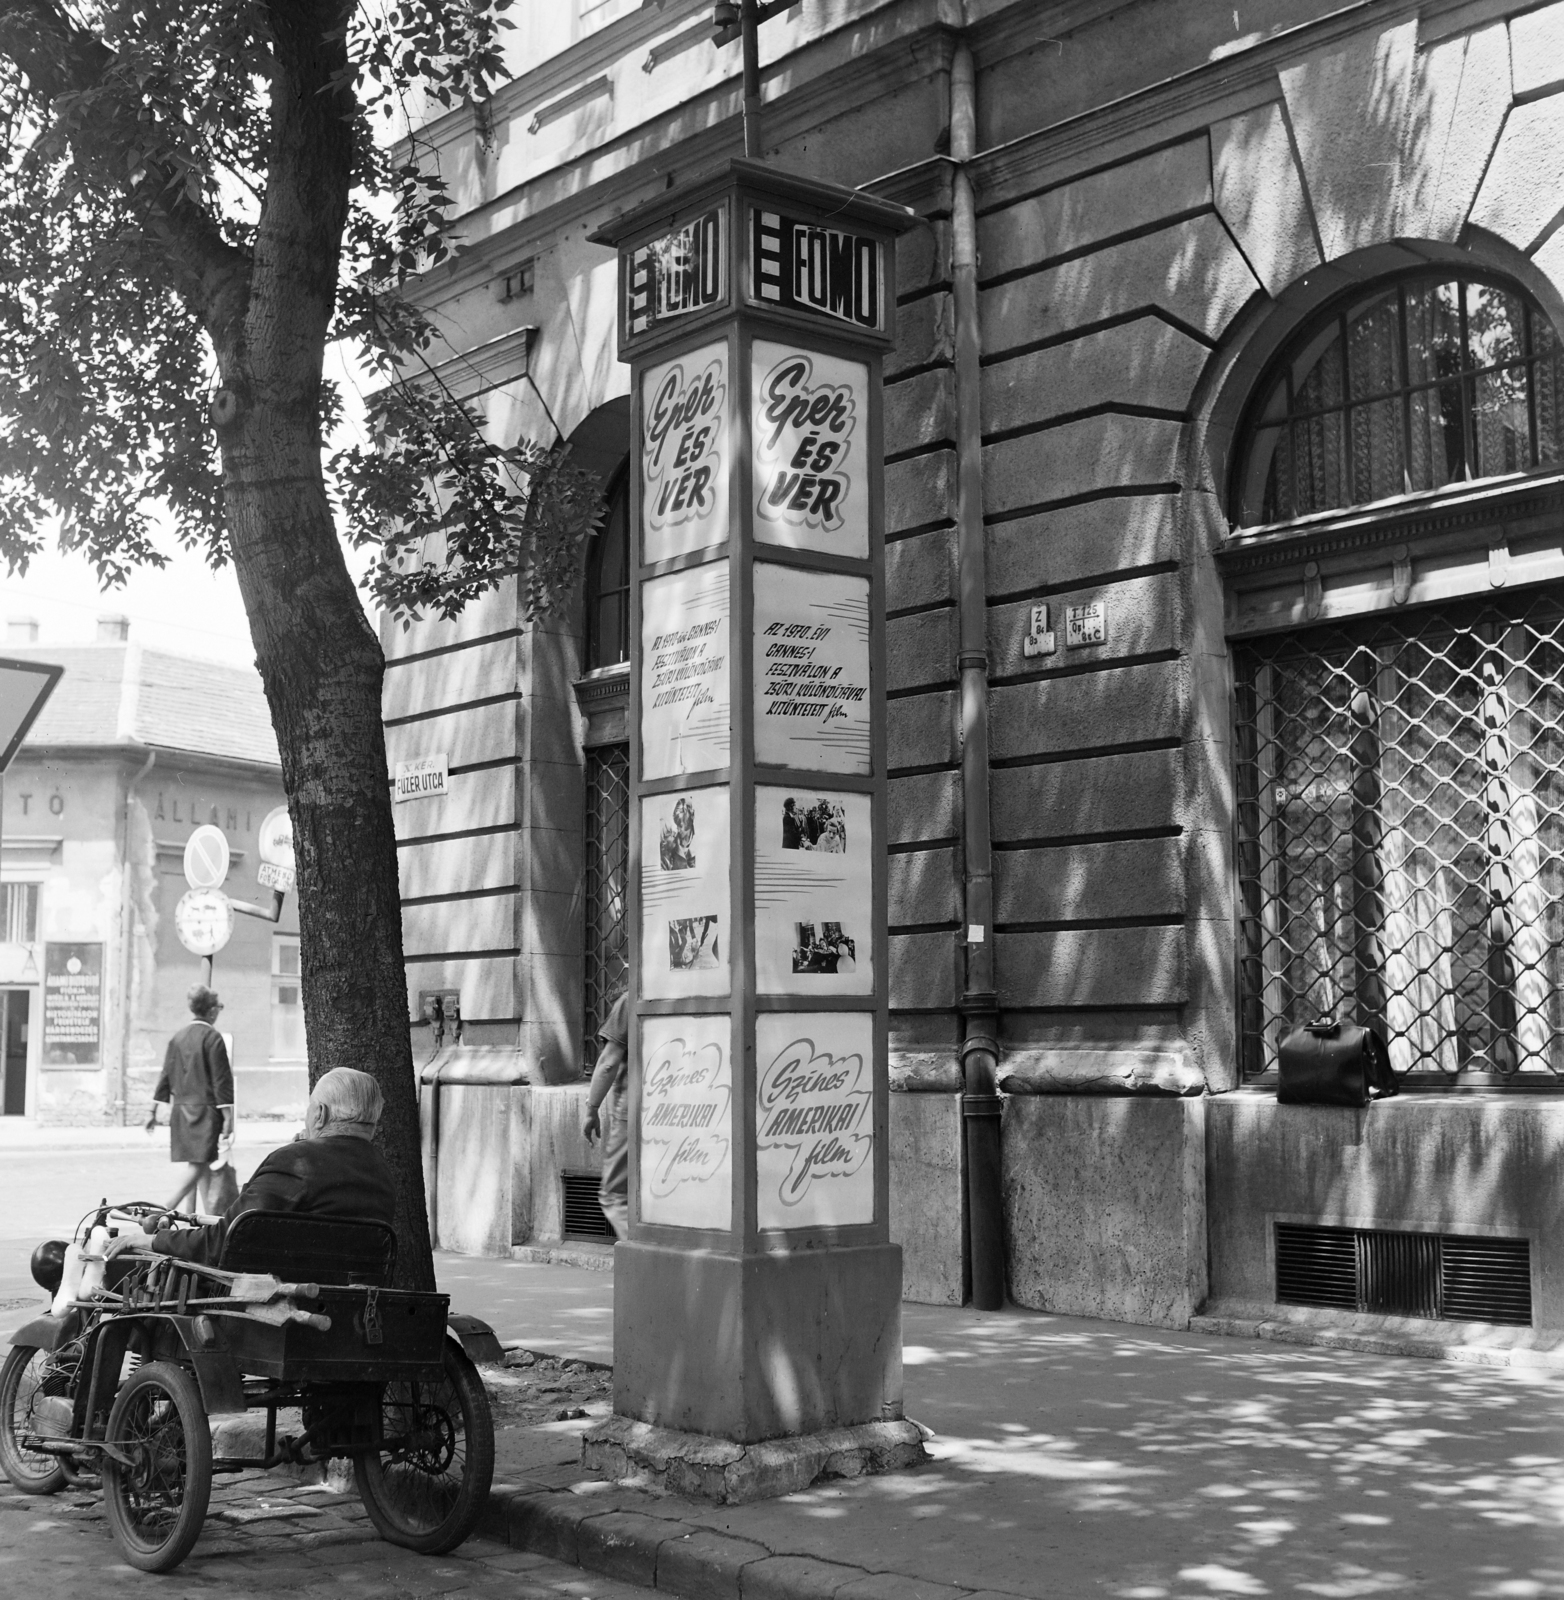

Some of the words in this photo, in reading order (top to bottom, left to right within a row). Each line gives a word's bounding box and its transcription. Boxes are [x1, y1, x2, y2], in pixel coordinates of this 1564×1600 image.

[649, 371, 717, 467] Eper
[765, 362, 847, 450] Eper
[673, 425, 711, 469] ÉS
[790, 430, 840, 474] ÉS
[657, 466, 711, 516] VÉR
[767, 472, 841, 523] VÉR
[1035, 611, 1042, 622] Z
[1072, 608, 1080, 619] T
[1081, 604, 1097, 617] 125
[763, 622, 786, 636] AZ
[810, 623, 832, 641] ÉVI
[829, 666, 843, 680] A
[822, 702, 848, 724] film
[421, 771, 444, 791] UTCA
[647, 1103, 718, 1128] AMERIKAI
[765, 1103, 860, 1137] AMERIKAI
[661, 1136, 710, 1184] film
[790, 1137, 854, 1194] film
